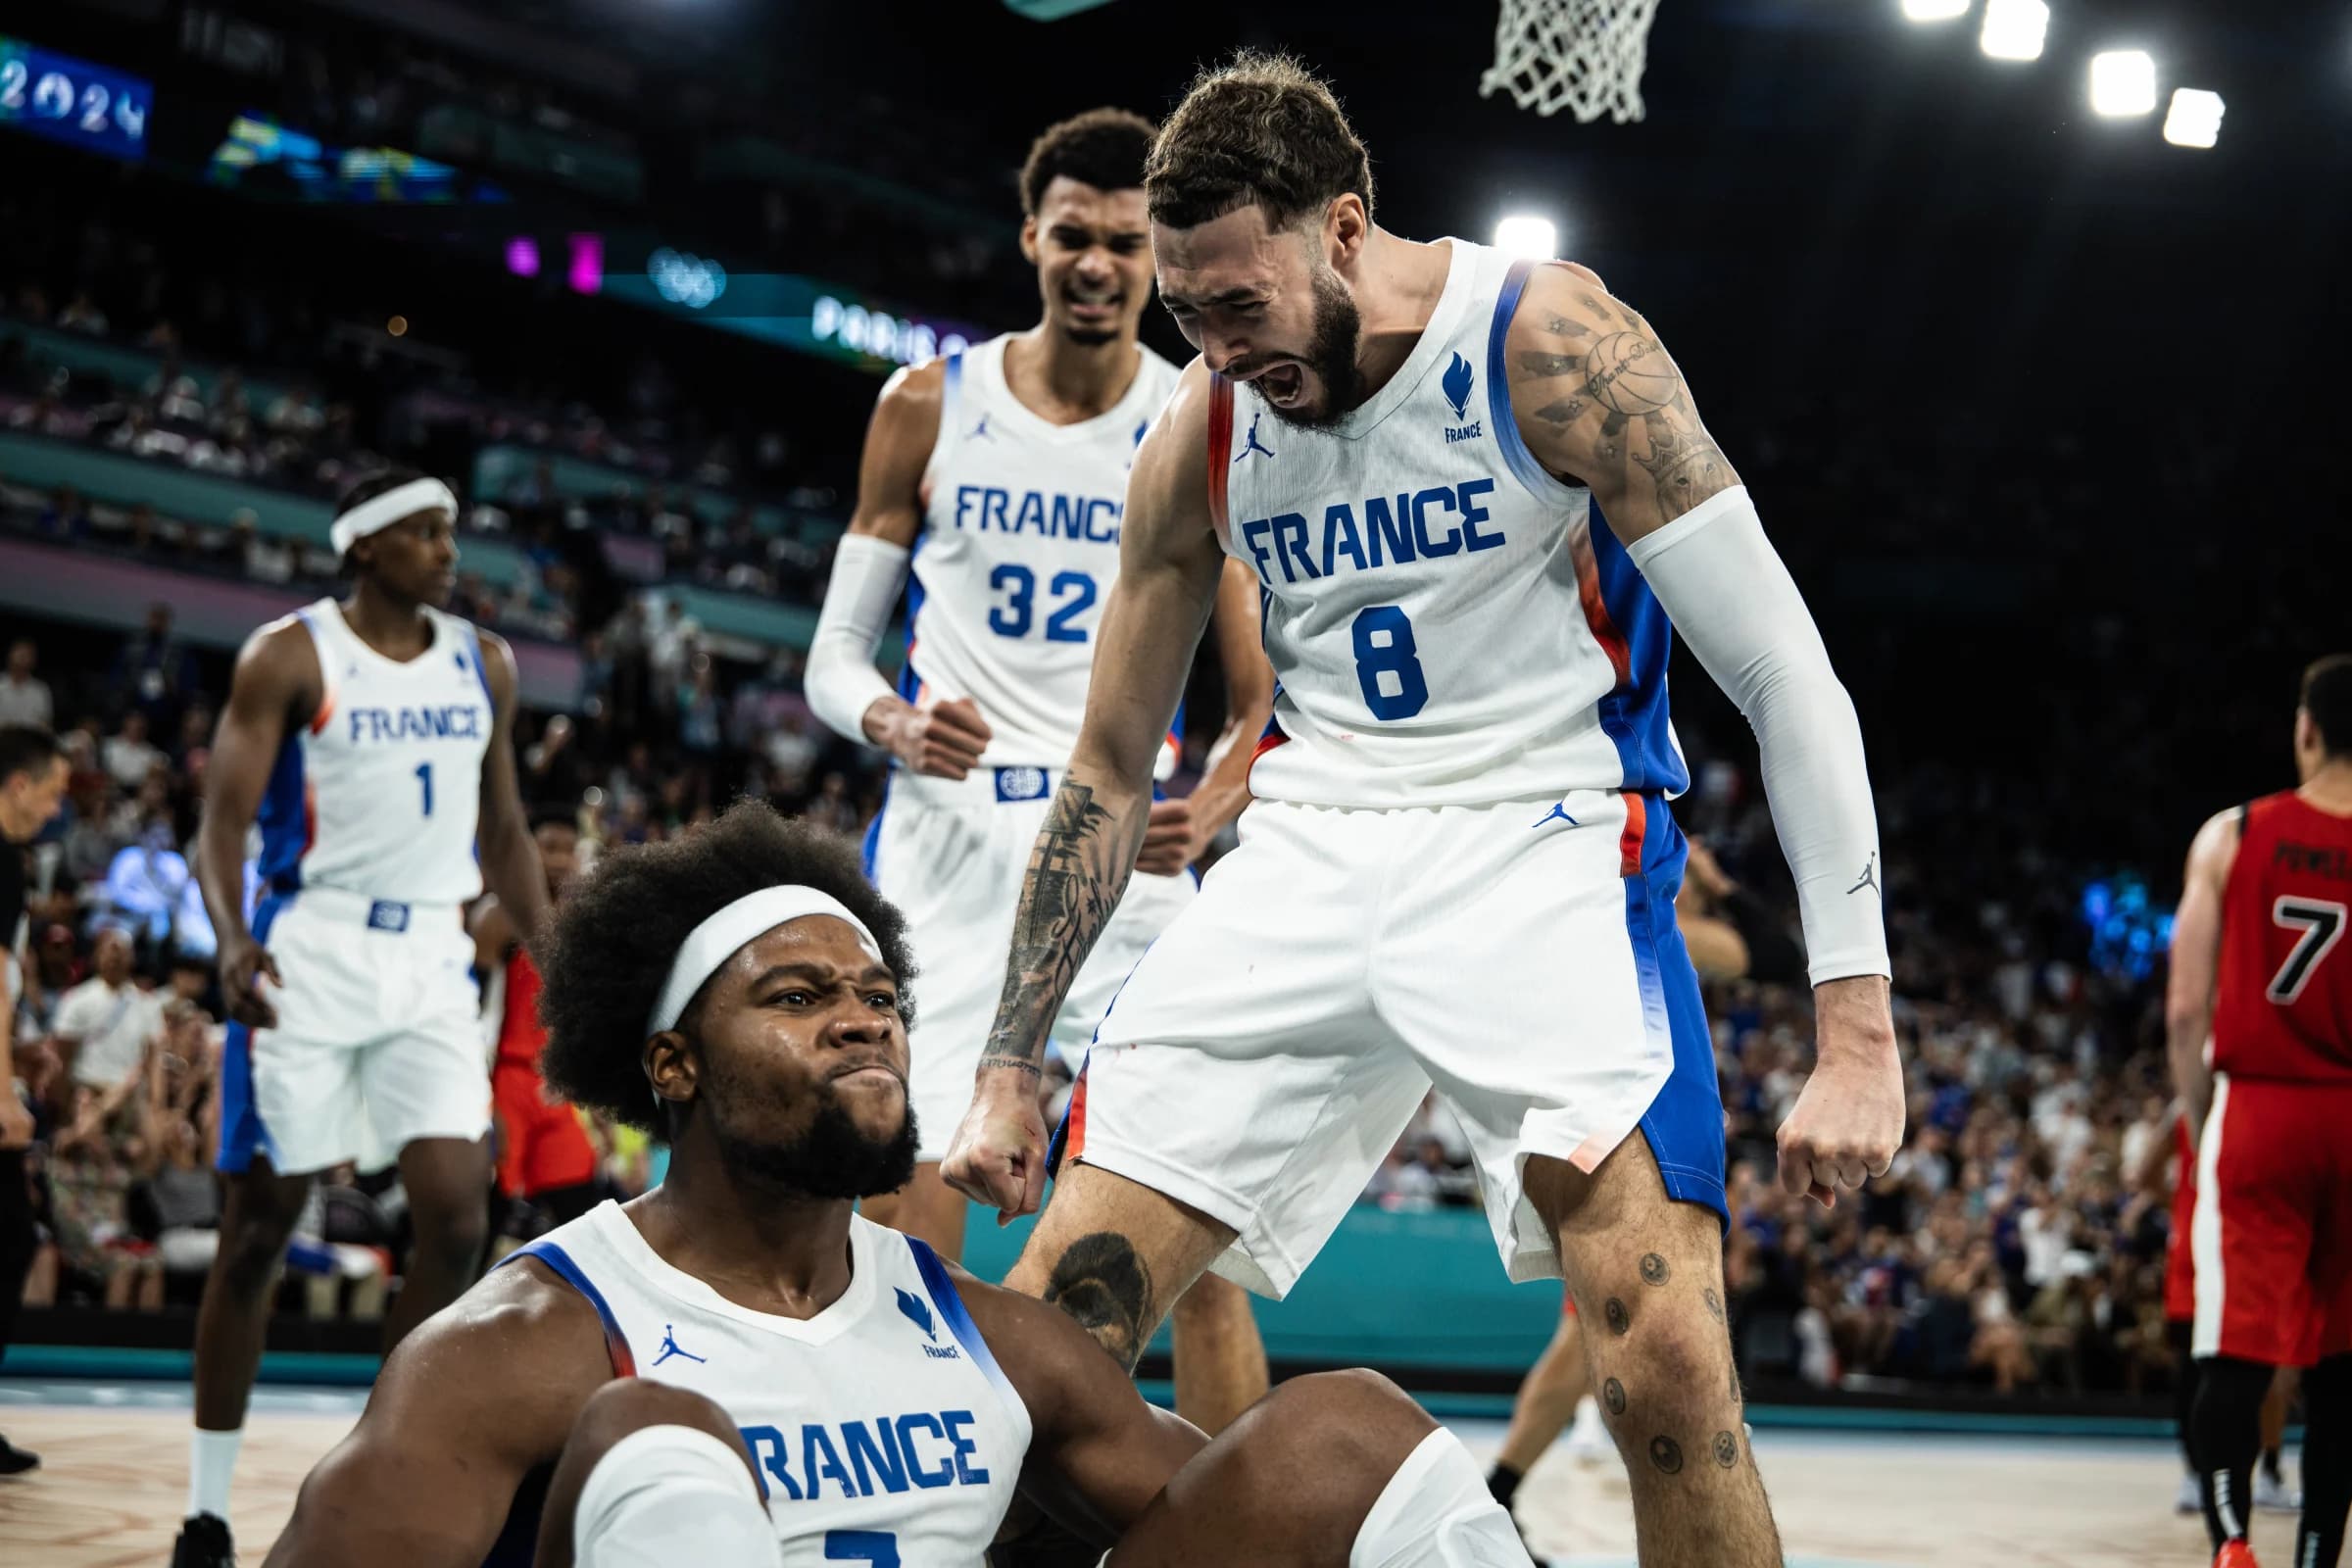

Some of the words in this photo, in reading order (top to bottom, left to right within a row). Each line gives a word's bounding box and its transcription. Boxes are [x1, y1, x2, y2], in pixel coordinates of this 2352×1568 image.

[0, 59, 145, 139] 2024
[1445, 420, 1482, 444] FRANCE
[956, 485, 1123, 545] FRANC
[1243, 478, 1506, 585] FRANCE
[988, 564, 1098, 643] 32
[1351, 606, 1429, 720] 8
[351, 707, 477, 741] FRANCE
[415, 761, 433, 817] 1
[2266, 895, 2347, 1005] 7
[922, 1344, 960, 1359] FRANCE
[739, 1410, 990, 1500] RANCE
